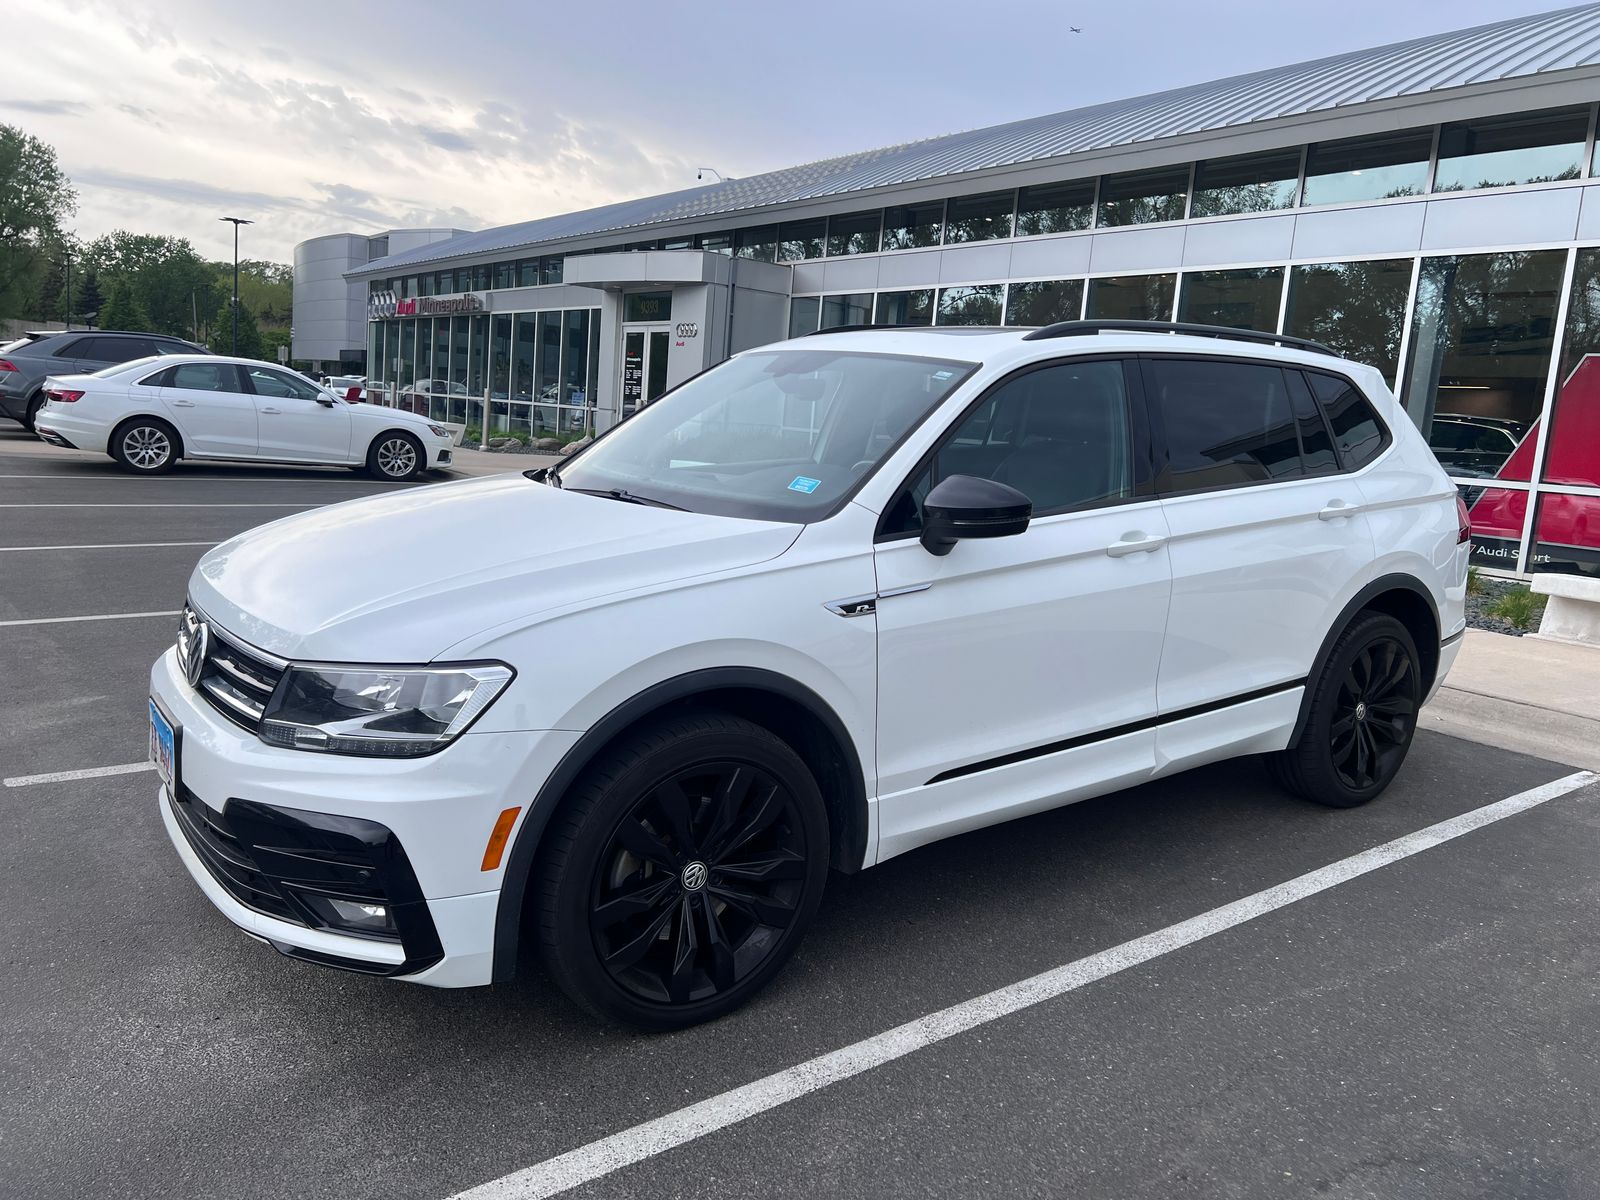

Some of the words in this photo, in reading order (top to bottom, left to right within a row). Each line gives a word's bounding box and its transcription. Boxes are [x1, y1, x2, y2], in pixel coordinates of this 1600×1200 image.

[396, 298, 416, 315] Audi
[1476, 545, 1508, 558] Audi
[1510, 550, 1551, 563] Srt
